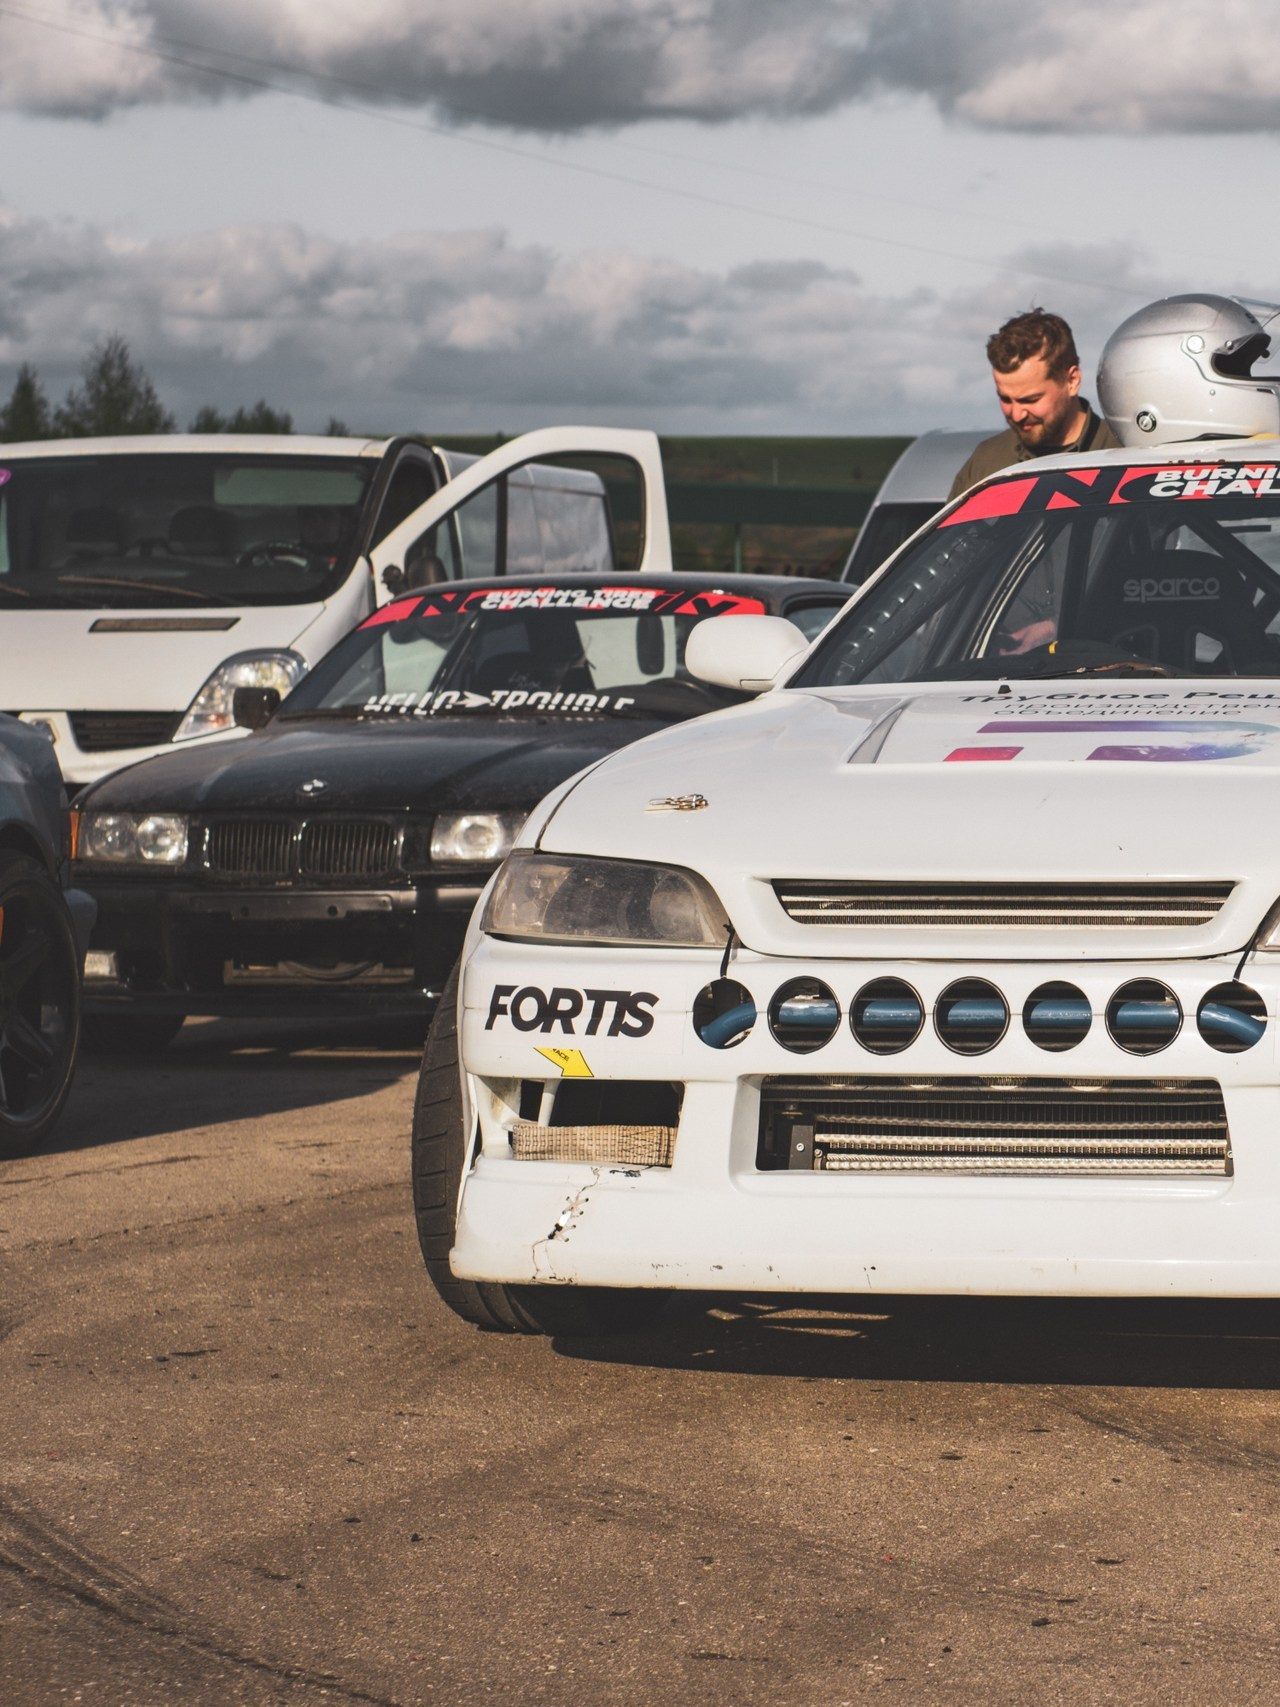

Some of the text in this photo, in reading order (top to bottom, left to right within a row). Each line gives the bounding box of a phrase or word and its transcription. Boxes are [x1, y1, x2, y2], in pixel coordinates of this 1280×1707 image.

[486, 590, 656, 600] BURNING TIRES
[1123, 577, 1220, 603] sparco
[480, 597, 652, 610] CHALLENGE
[957, 693, 1170, 703] Трубное
[485, 984, 660, 1038] FORTIS
